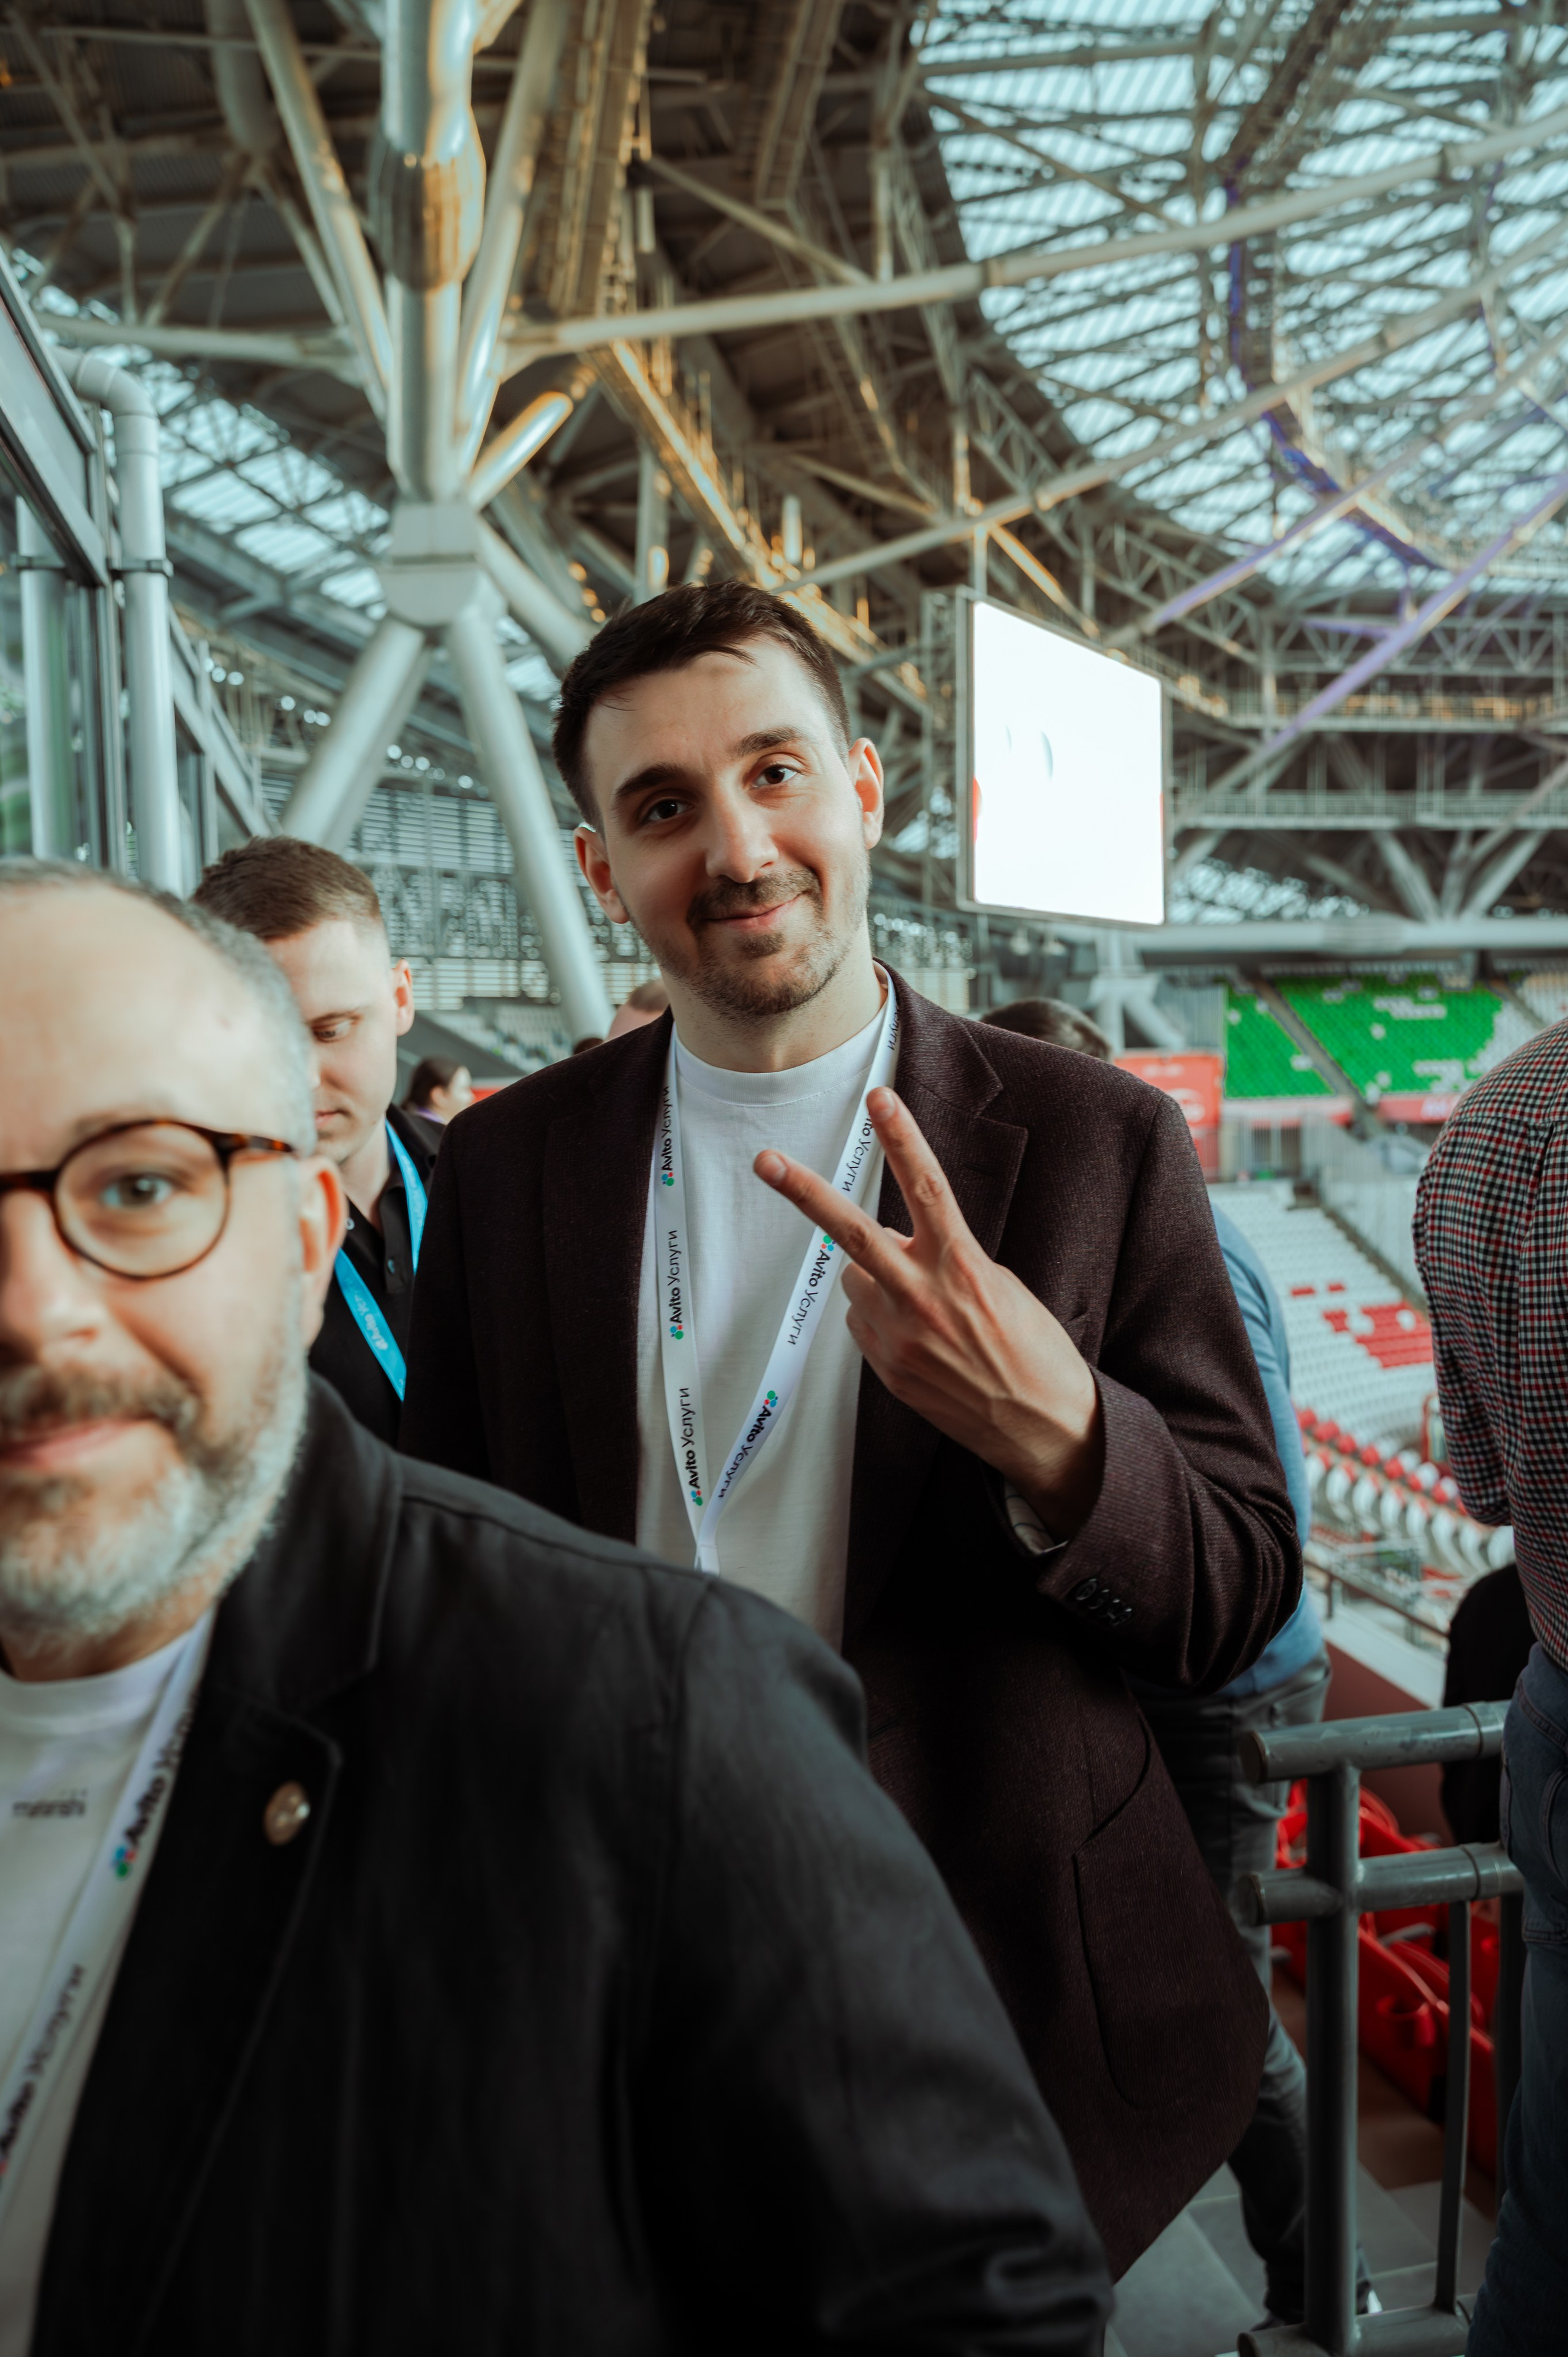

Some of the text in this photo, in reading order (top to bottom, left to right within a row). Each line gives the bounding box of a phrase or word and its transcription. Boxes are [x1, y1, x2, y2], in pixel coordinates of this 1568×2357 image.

[661, 1086, 673, 1171] Avito Услуги
[842, 1139, 871, 1192] Услуги
[667, 1230, 682, 1324] Avito Услуги
[787, 1250, 831, 1345] Avito Услуги
[679, 1387, 701, 1489] Avito Услуги
[718, 1405, 772, 1498] Avito Услуги
